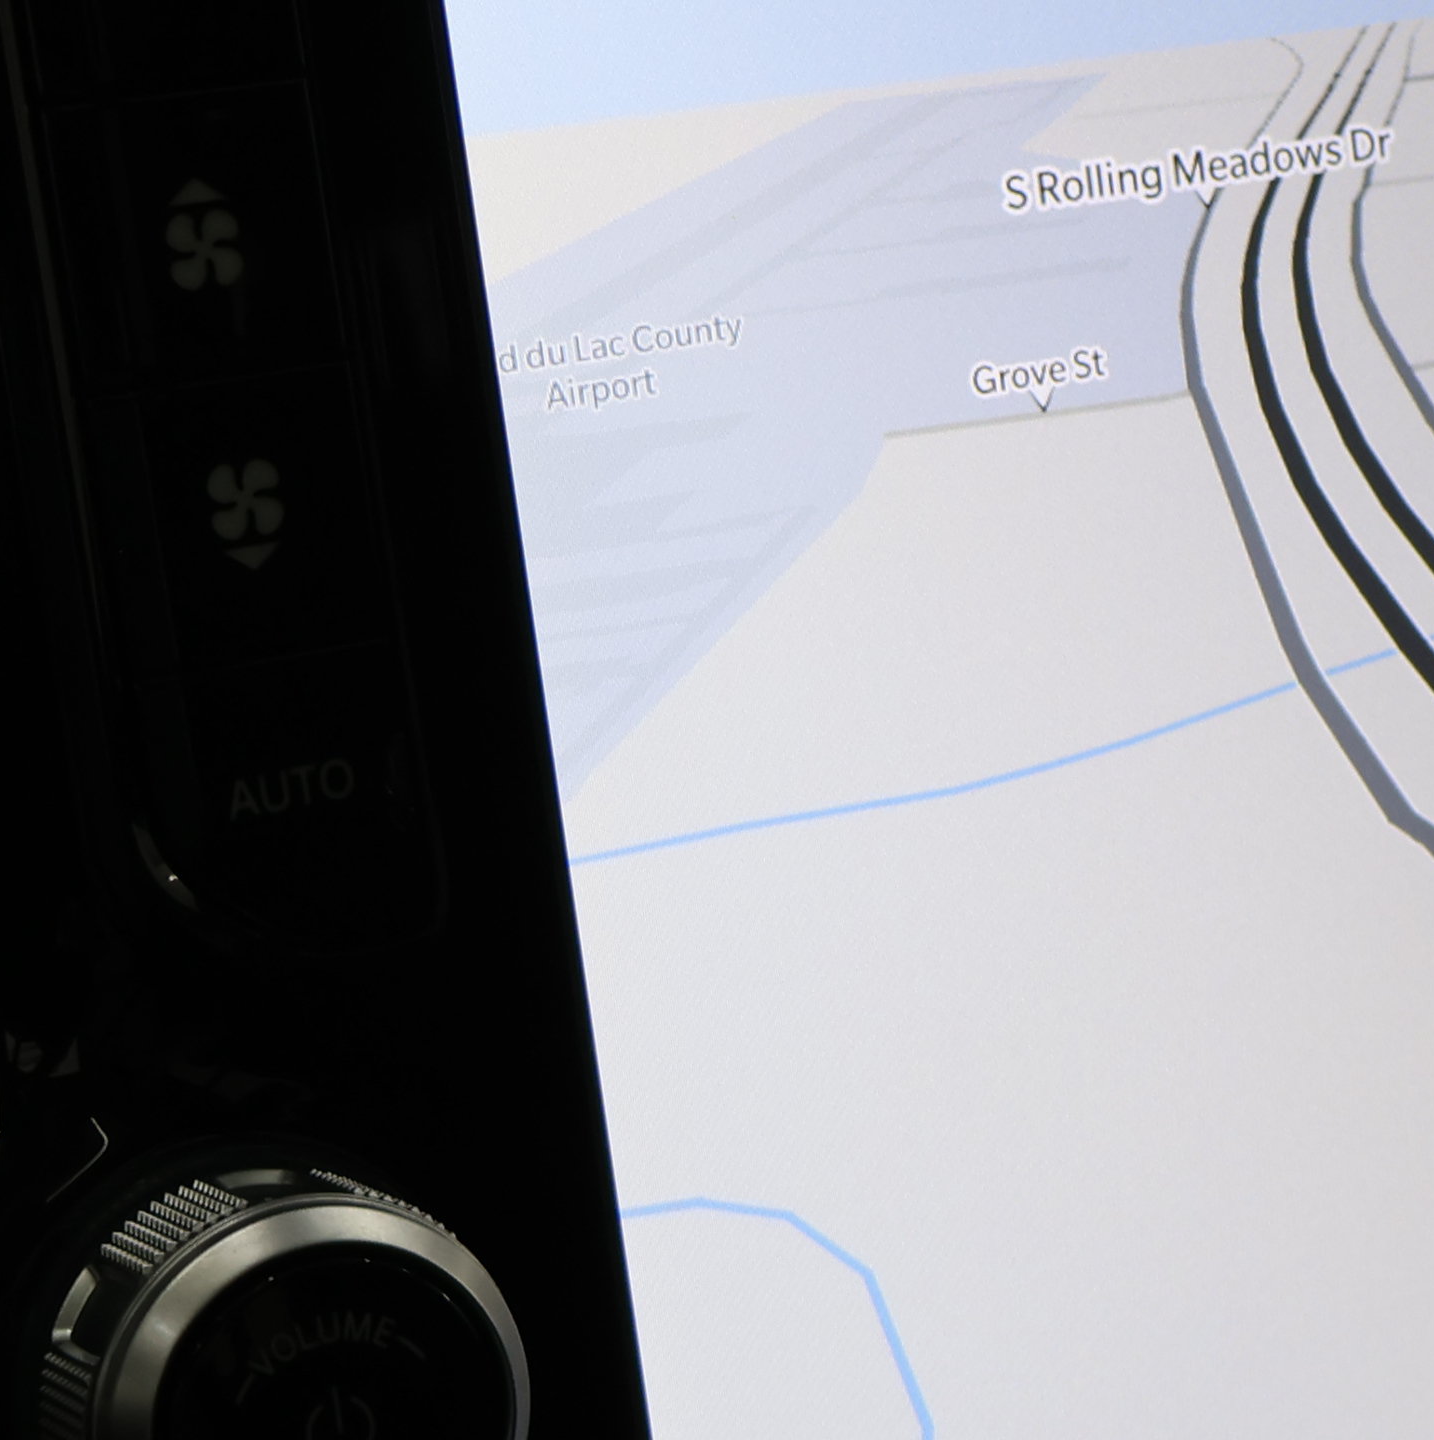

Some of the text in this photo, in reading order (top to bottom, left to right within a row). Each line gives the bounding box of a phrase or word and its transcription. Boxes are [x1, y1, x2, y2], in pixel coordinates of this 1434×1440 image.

[1006, 128, 1391, 209] S Rolling Meadows Dr
[526, 340, 565, 369] du
[573, 335, 624, 361] Lac
[632, 316, 742, 353] County
[547, 369, 656, 409] Airport
[973, 349, 1106, 395] Grove St
[227, 758, 357, 822] AUTO
[248, 1310, 399, 1381] VOLUME
